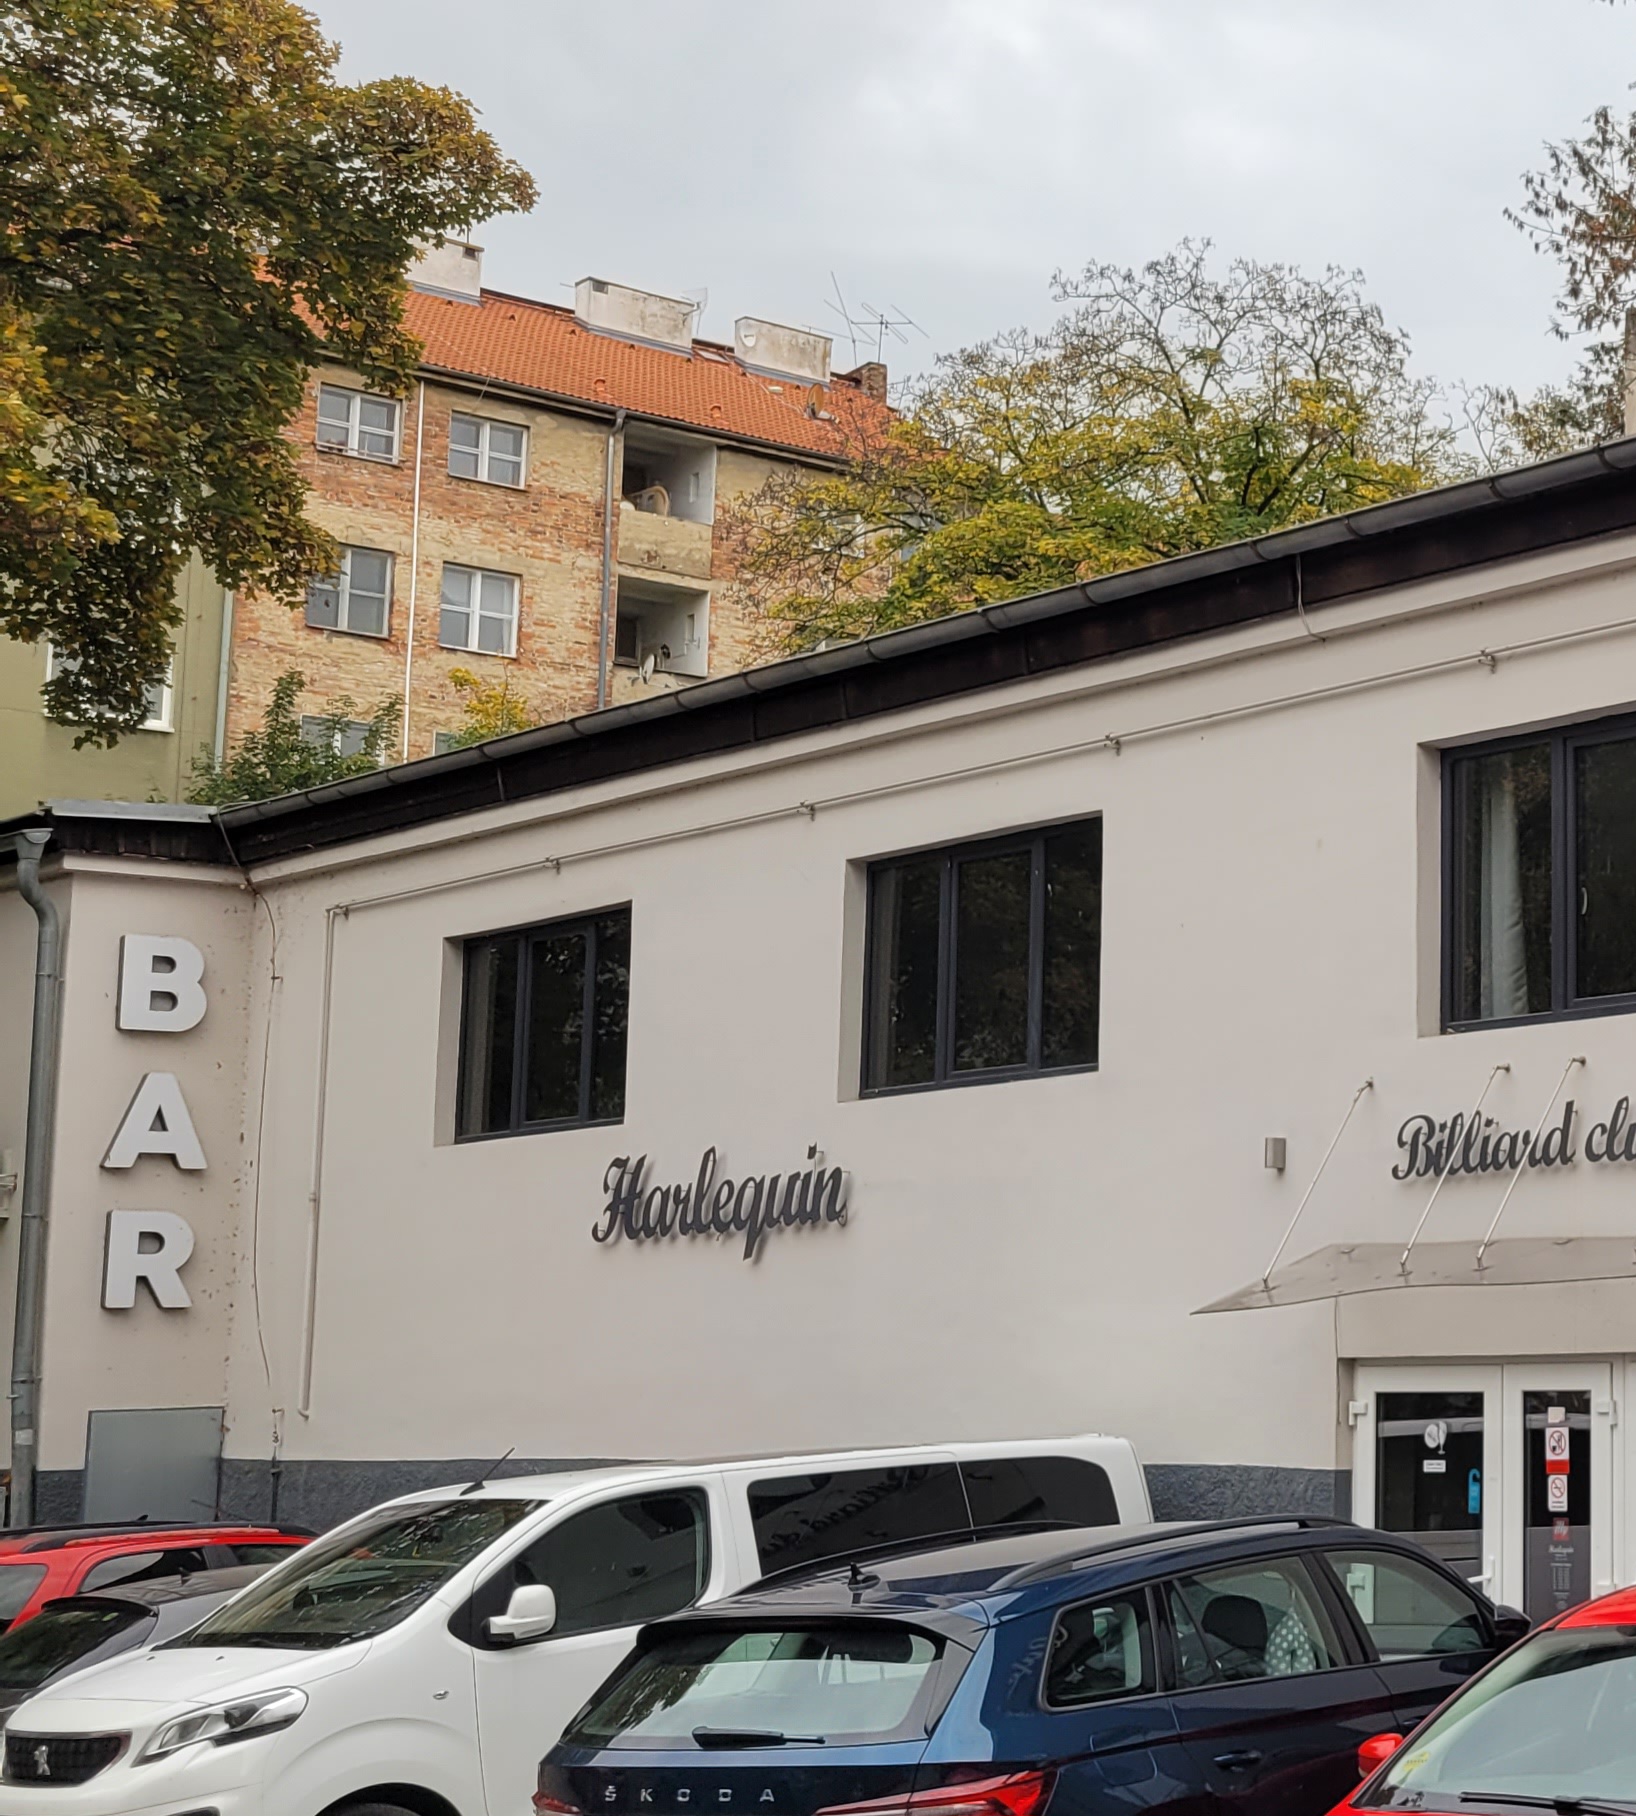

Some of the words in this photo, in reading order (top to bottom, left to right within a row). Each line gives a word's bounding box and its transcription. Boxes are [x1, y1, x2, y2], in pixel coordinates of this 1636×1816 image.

[100, 934, 208, 1309] BAR
[1392, 1099, 1576, 1180] Billiard
[592, 1142, 848, 1262] Harlequin
[605, 1785, 775, 1802] ŠKODA
